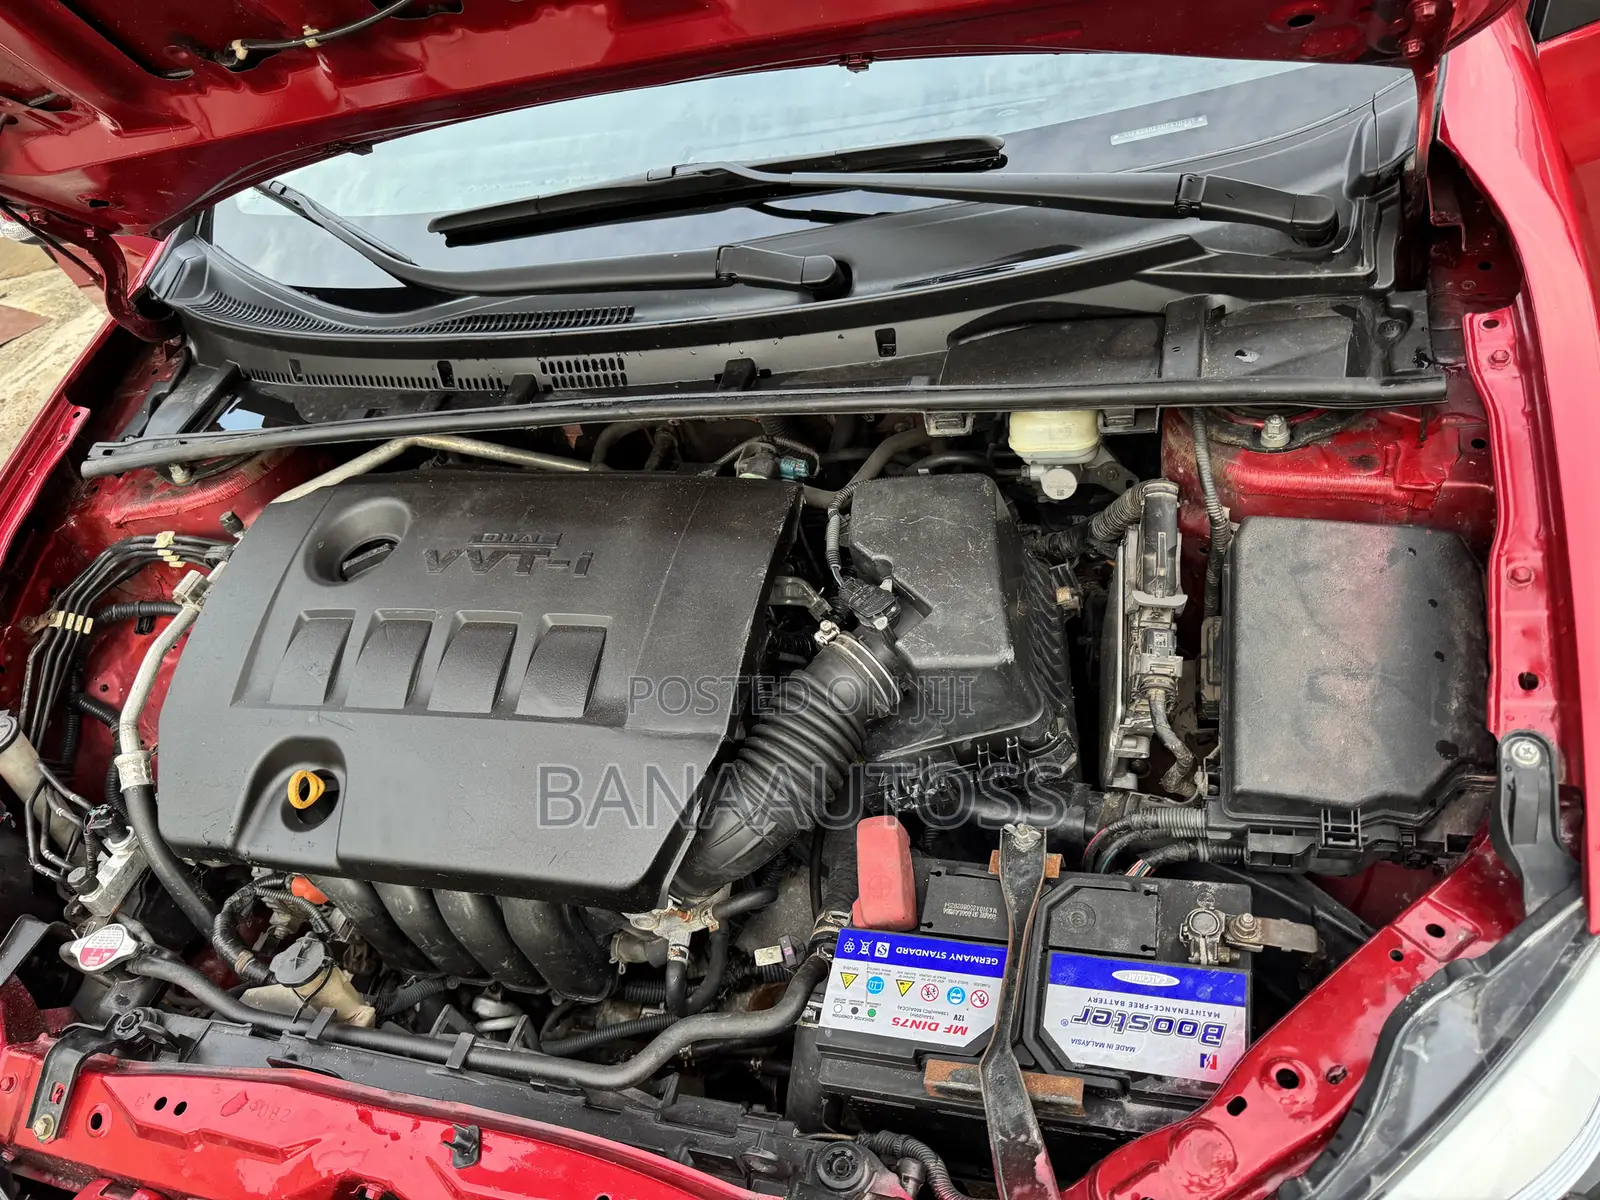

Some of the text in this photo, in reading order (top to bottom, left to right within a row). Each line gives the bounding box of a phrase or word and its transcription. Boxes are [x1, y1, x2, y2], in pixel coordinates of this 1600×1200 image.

[895, 946, 999, 967] GERMANY STANDARD
[1127, 971, 1168, 984] CALCIUM
[1087, 996, 1221, 1019] MAINTENANCE-FREE BATTERY
[890, 1016, 970, 1036] MF DIN75
[953, 1013, 966, 1023] 12V
[1070, 1005, 1228, 1048] Booster
[1070, 1037, 1106, 1049] MALAYSIA
[1114, 1043, 1137, 1053] MADE
